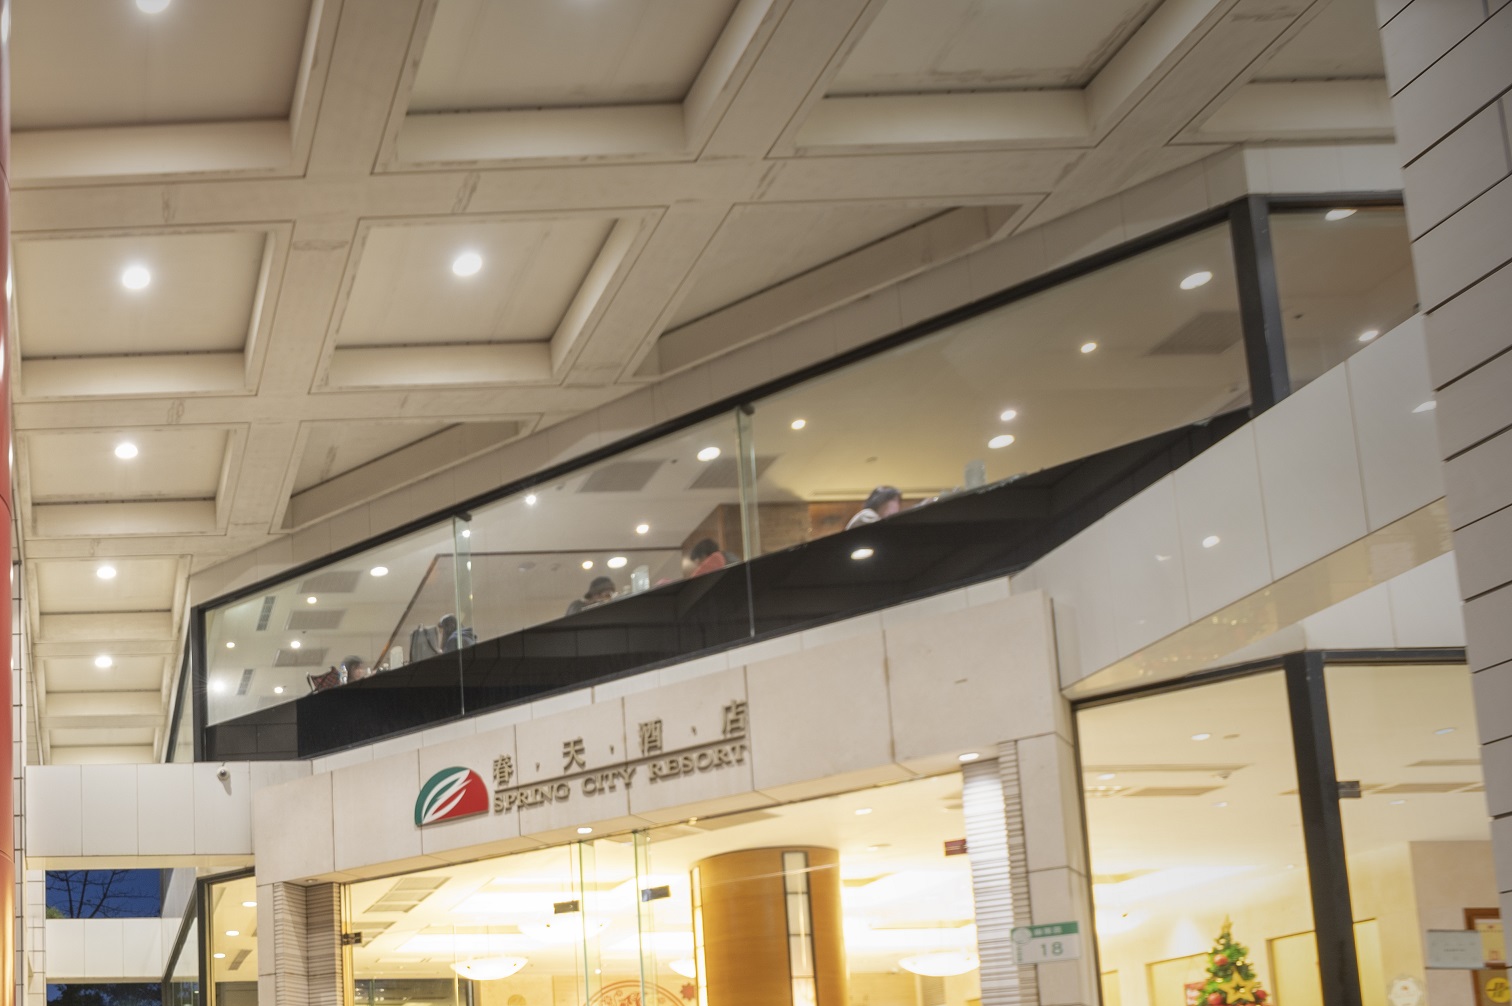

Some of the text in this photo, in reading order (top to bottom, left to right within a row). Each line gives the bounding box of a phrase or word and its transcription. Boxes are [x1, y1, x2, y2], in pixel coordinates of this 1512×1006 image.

[494, 744, 746, 814] SPRING CITY RESORT
[1040, 941, 1064, 958] 18
